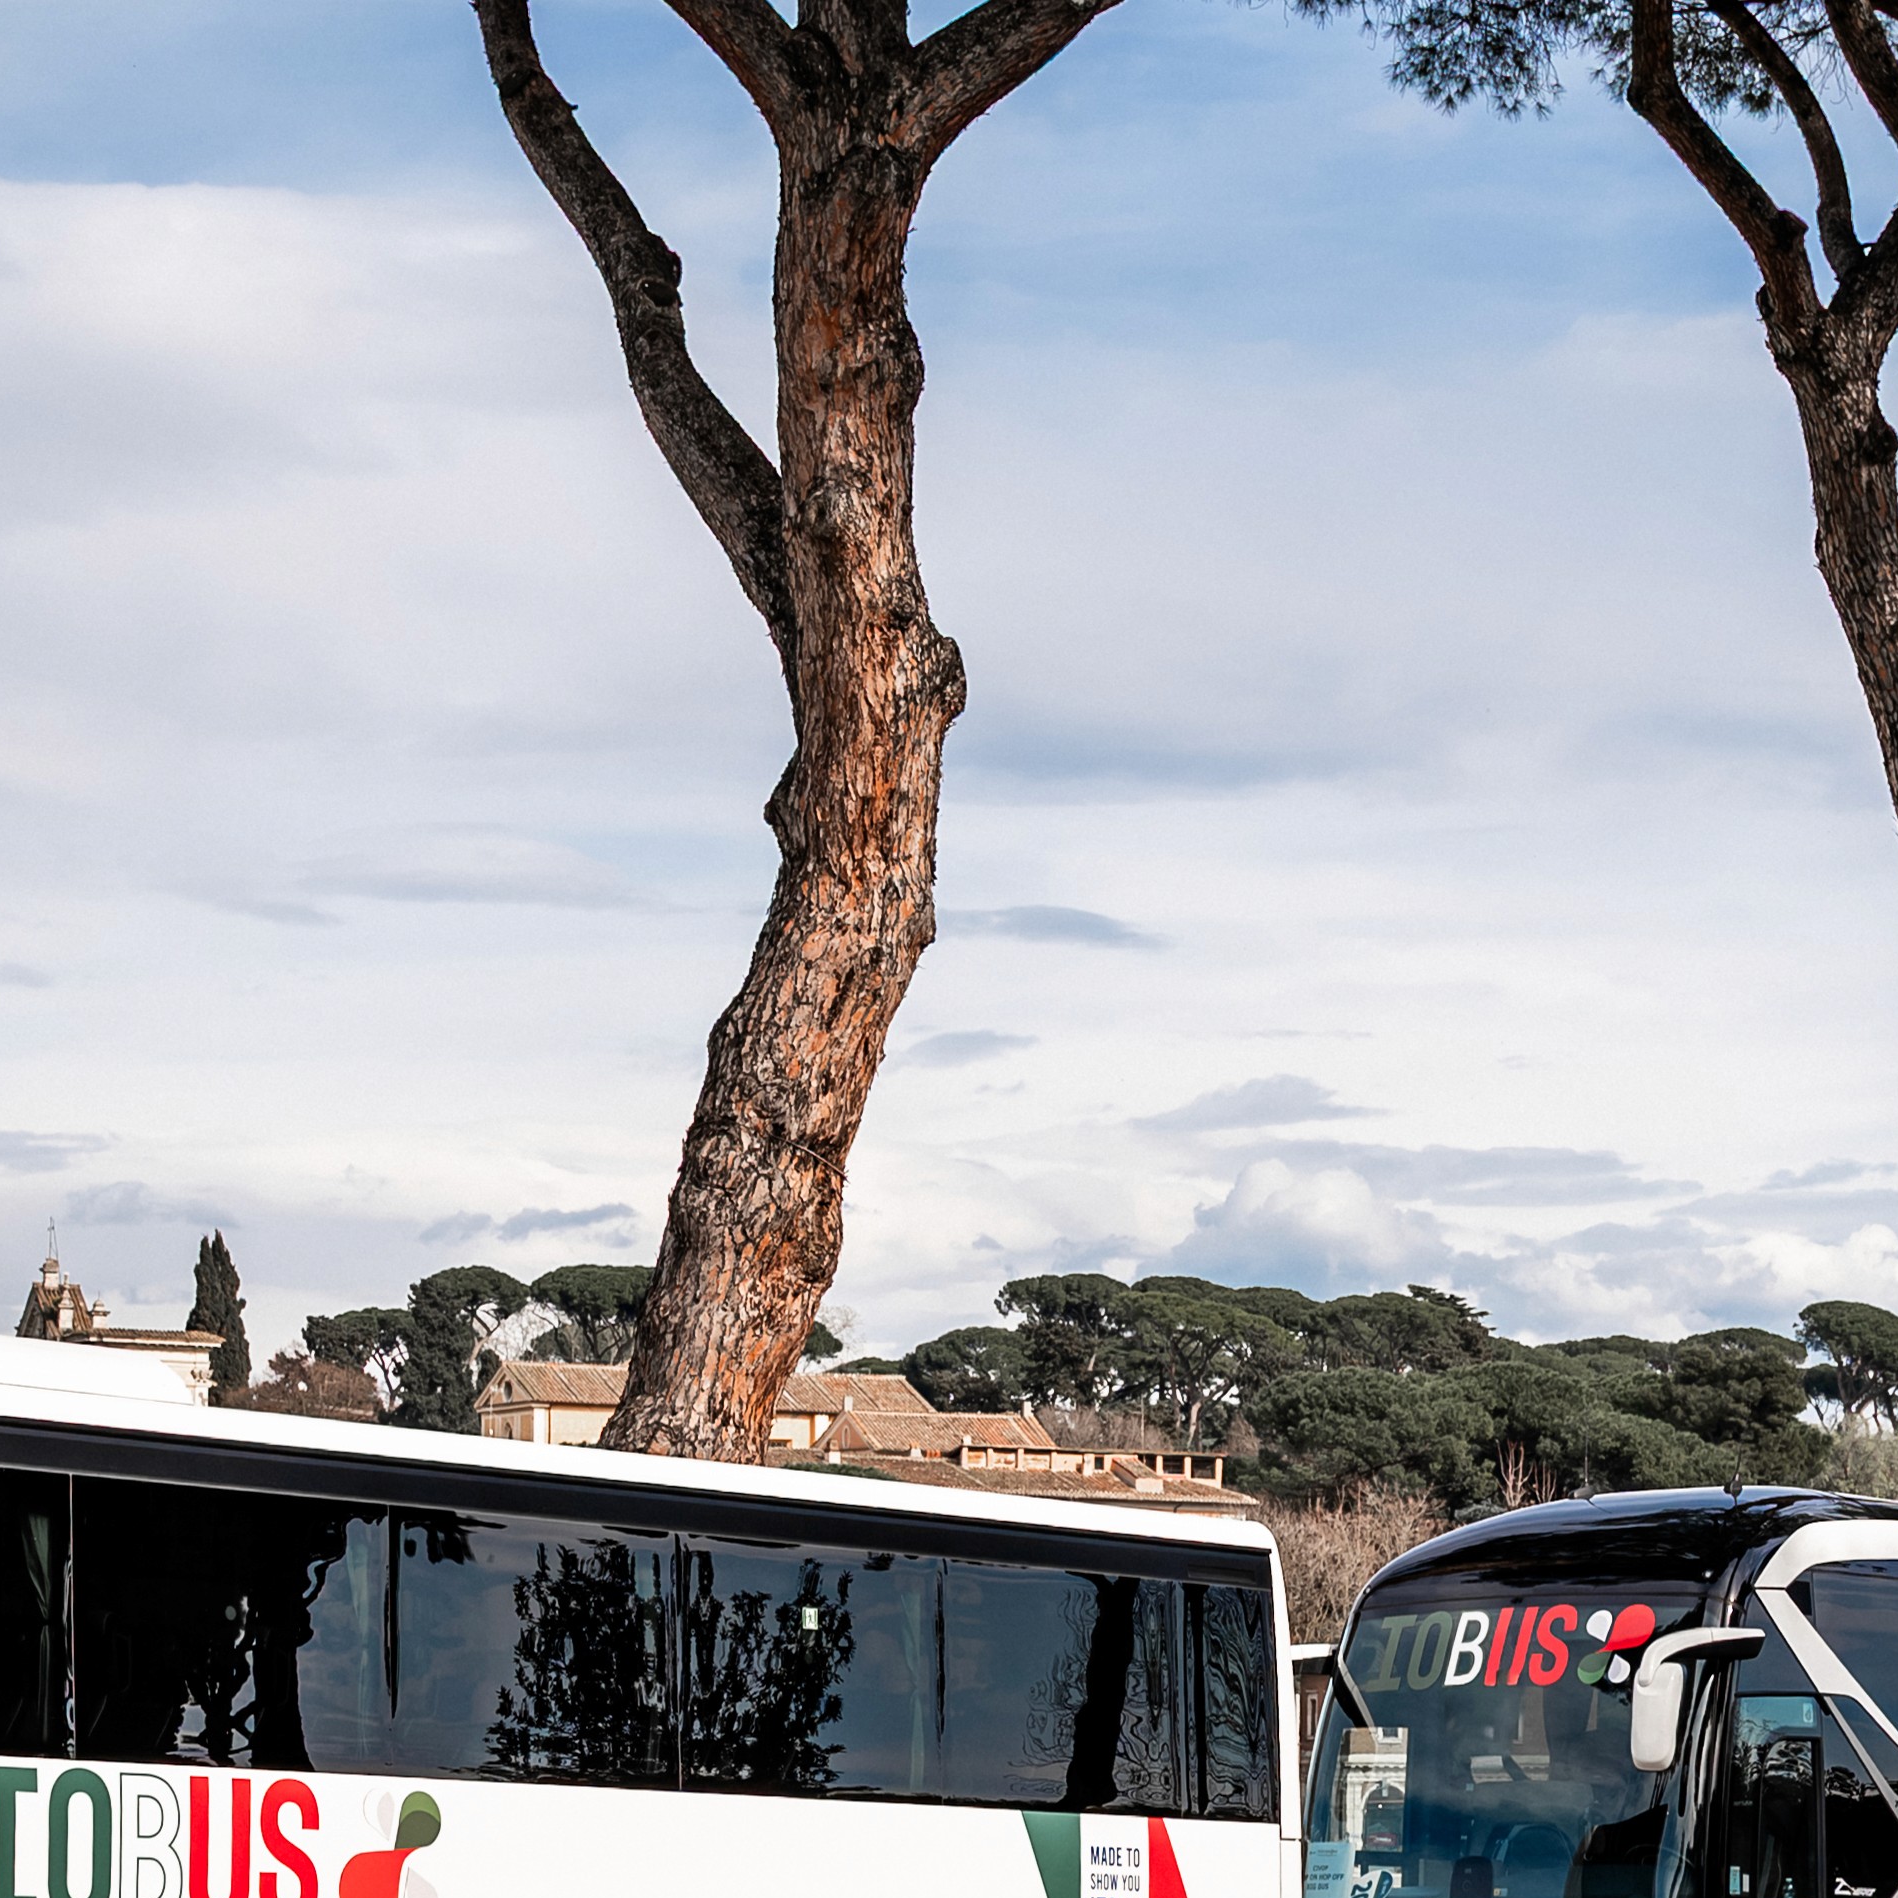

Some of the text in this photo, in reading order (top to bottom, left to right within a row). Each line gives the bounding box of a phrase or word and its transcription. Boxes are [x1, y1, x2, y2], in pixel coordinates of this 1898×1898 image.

[1362, 1604, 1578, 1692] IOBUS
[1090, 1846, 1140, 1867] MADE TO
[1090, 1873, 1140, 1892] SHOW YOU
